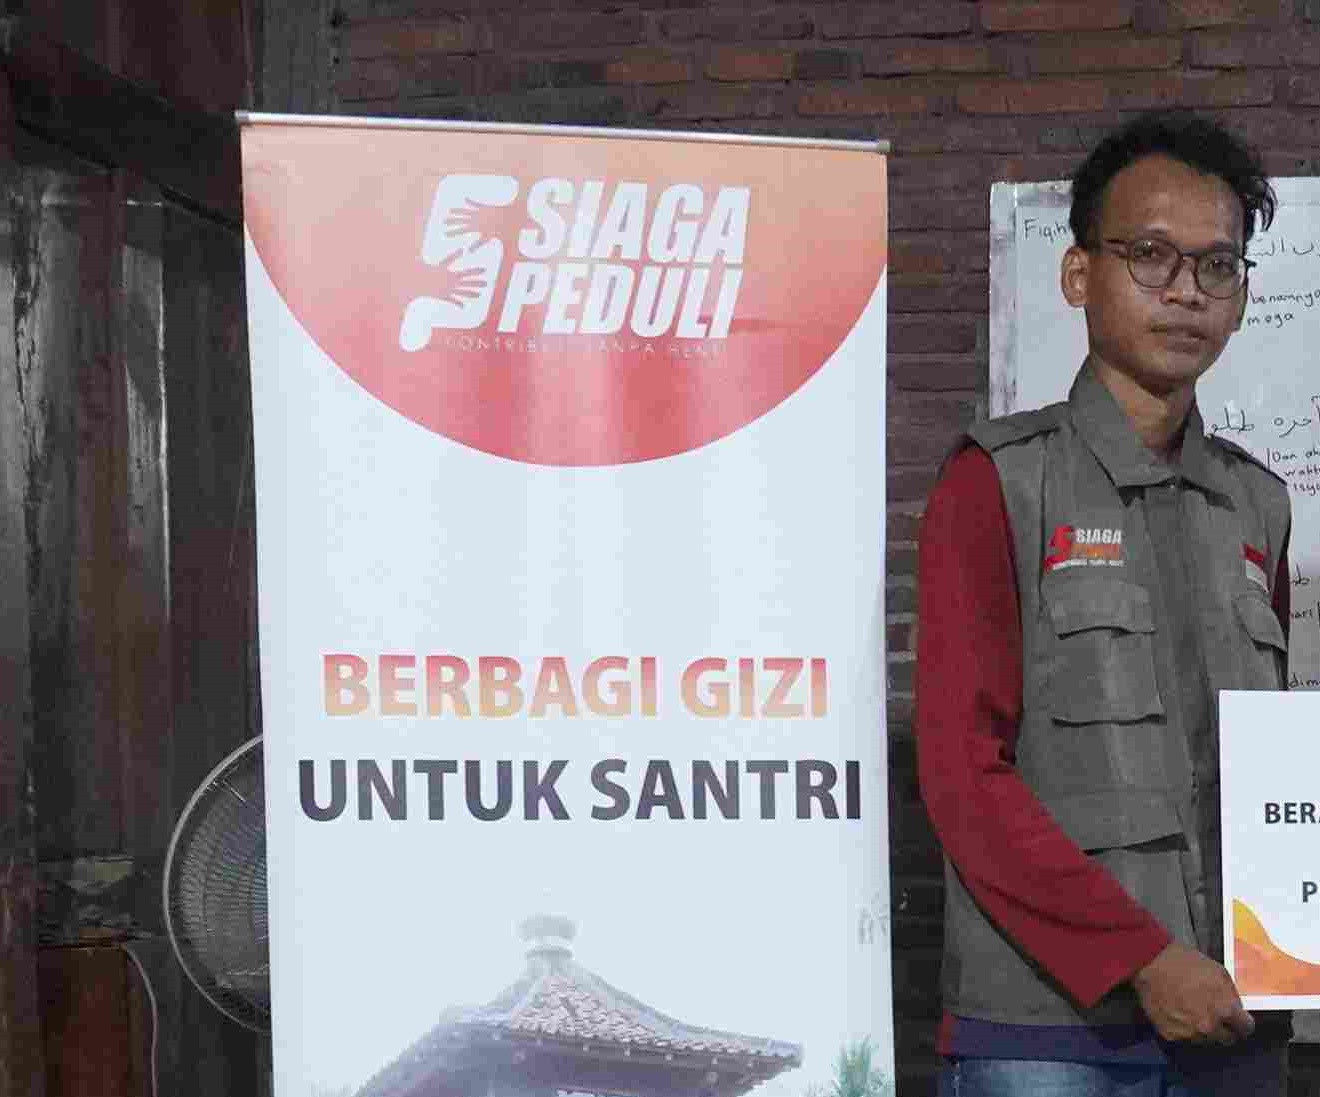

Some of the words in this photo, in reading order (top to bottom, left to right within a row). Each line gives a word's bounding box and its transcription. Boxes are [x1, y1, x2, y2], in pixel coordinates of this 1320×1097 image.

[518, 177, 749, 264] SIAGA
[497, 262, 744, 339] PEDULI
[322, 653, 657, 720] BERBAGI
[680, 656, 829, 720] GIZI
[298, 759, 571, 821] UNTUK
[590, 759, 860, 821] SANTRI
